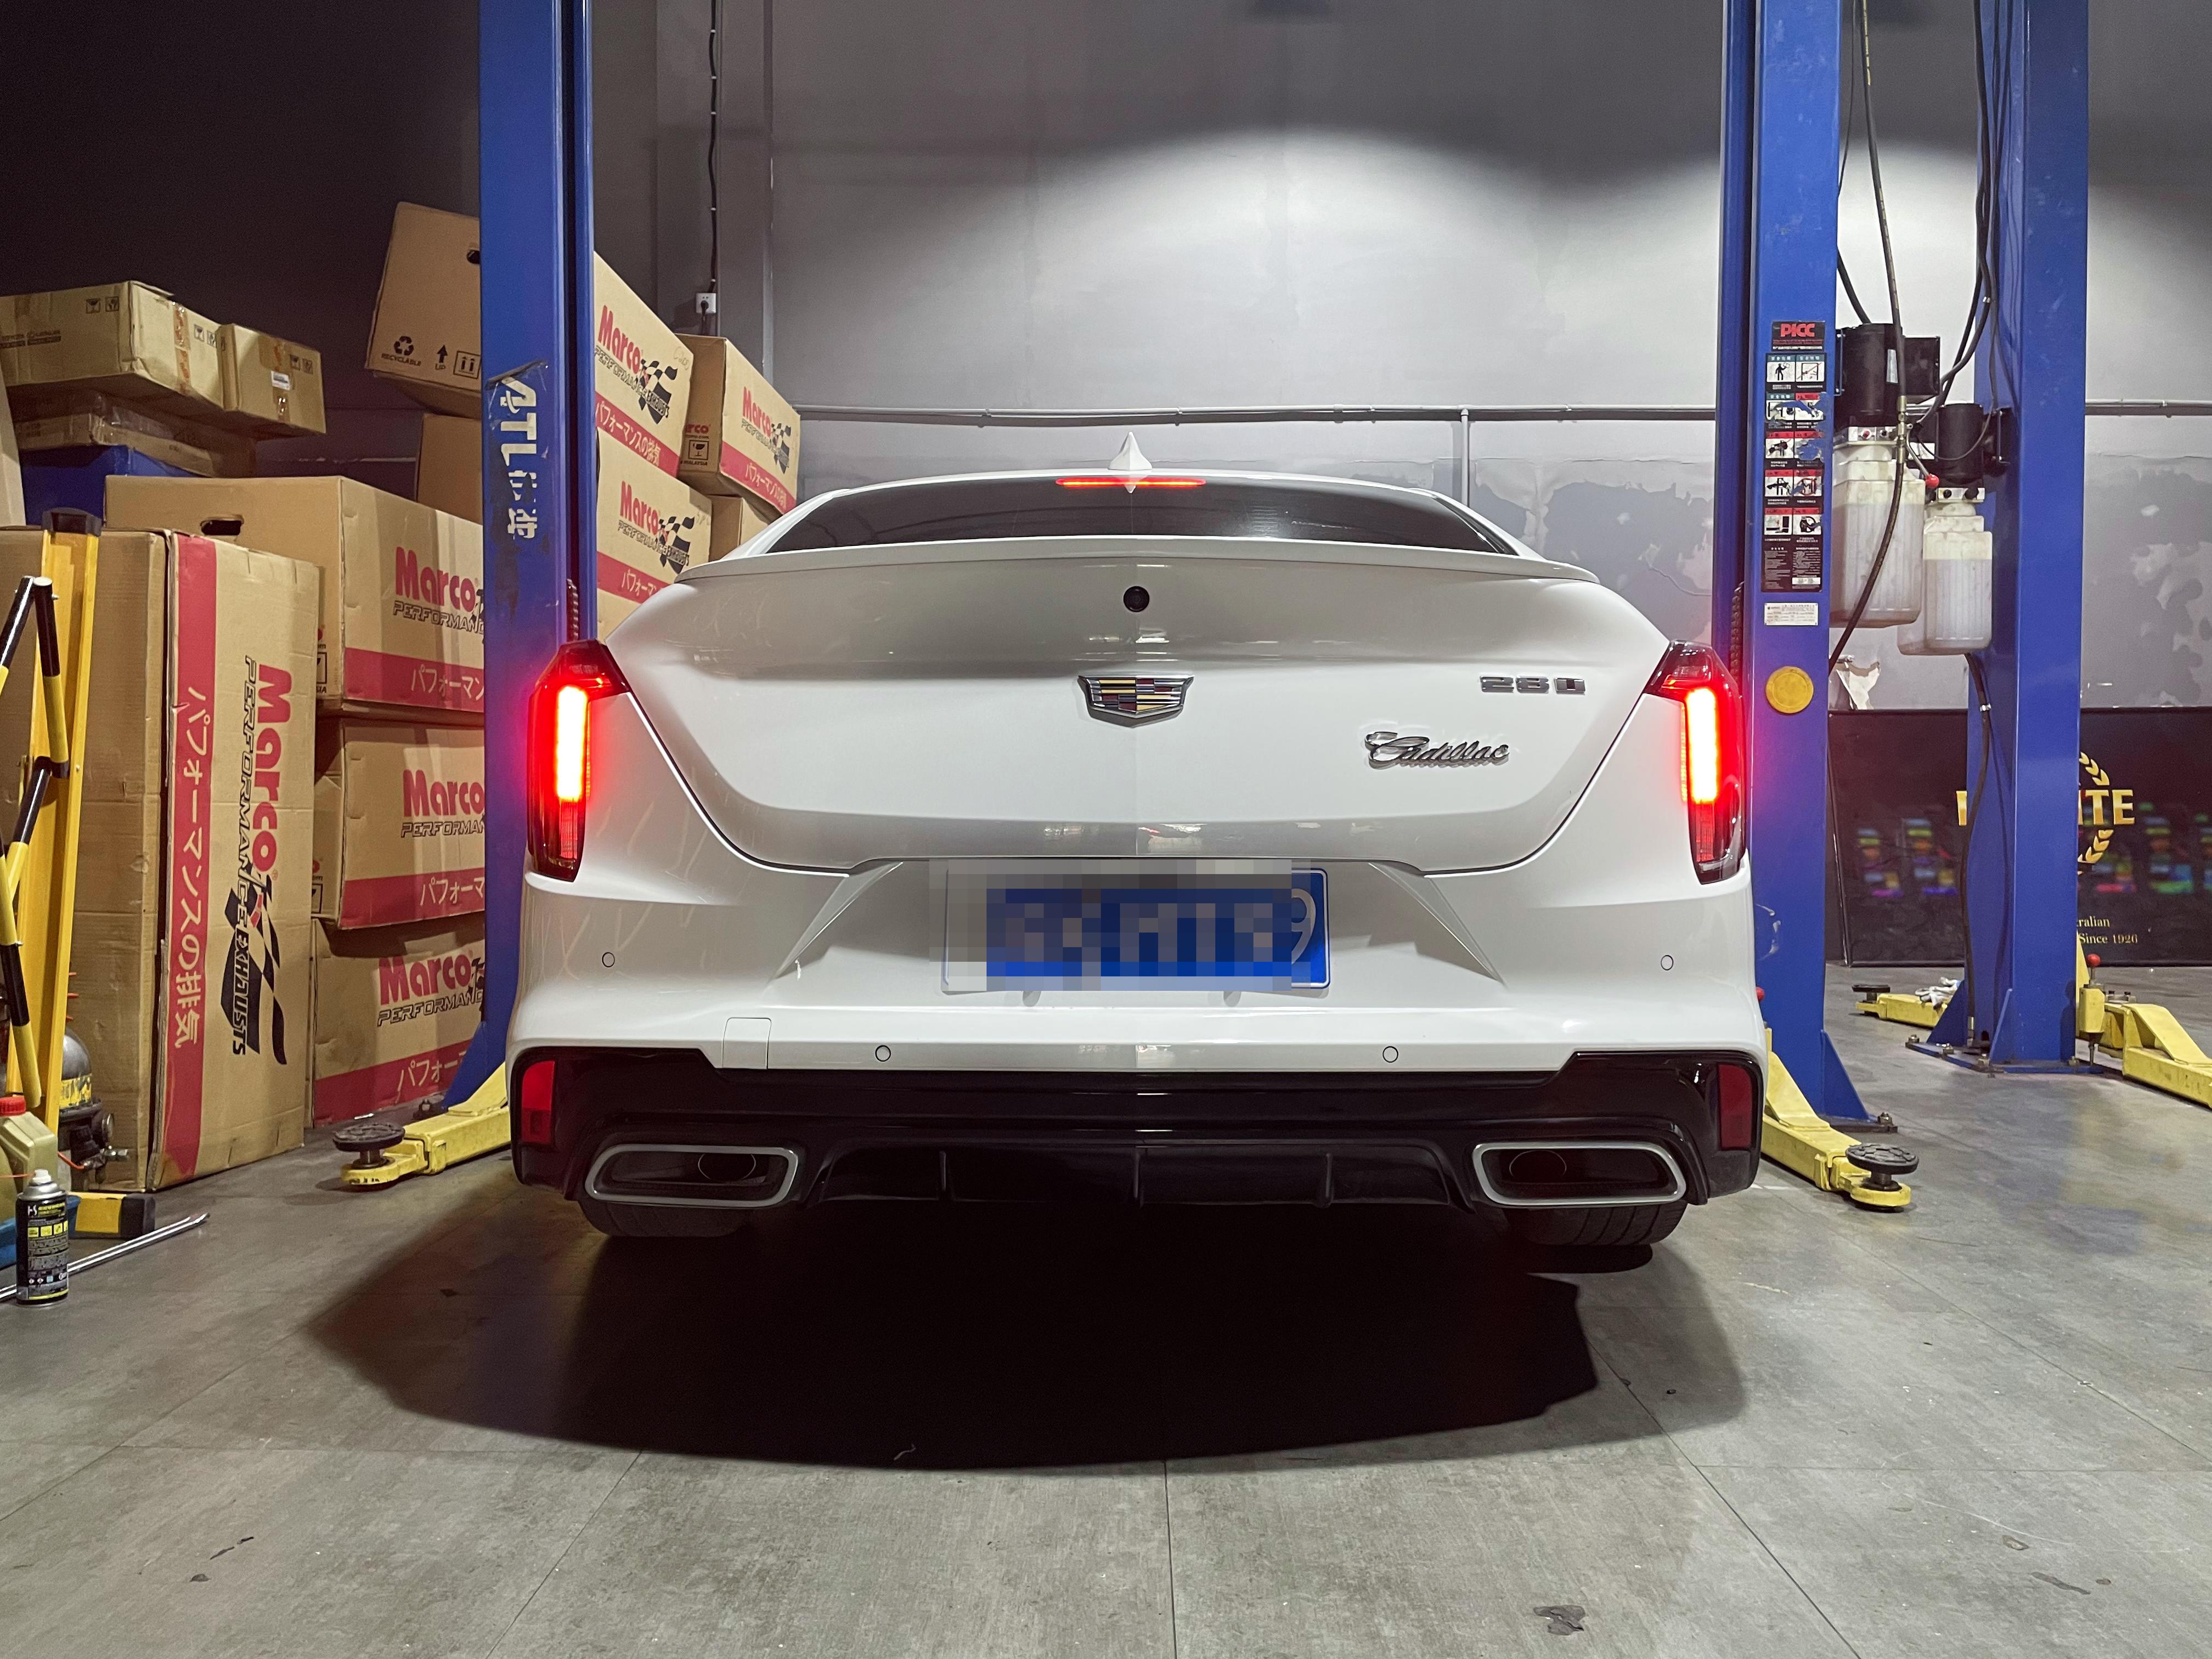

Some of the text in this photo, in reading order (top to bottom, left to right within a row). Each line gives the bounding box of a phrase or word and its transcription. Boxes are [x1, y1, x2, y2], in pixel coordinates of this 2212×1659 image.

[598, 305, 641, 374] Marco
[1780, 323, 1815, 337] PICC
[381, 353, 422, 366] RECYCLABLE
[686, 424, 709, 433] rco
[620, 481, 658, 535] Marco
[396, 546, 476, 612] Marco
[252, 664, 292, 872] Marco
[1365, 732, 1510, 768] Cadillac
[237, 655, 257, 927] PERFORMANCE
[403, 769, 484, 816] Marco
[174, 687, 211, 1048] パフォーマンスの排気
[2076, 916, 2110, 927] ralian
[2079, 933, 2108, 944] Since
[379, 954, 471, 1006] Marco
